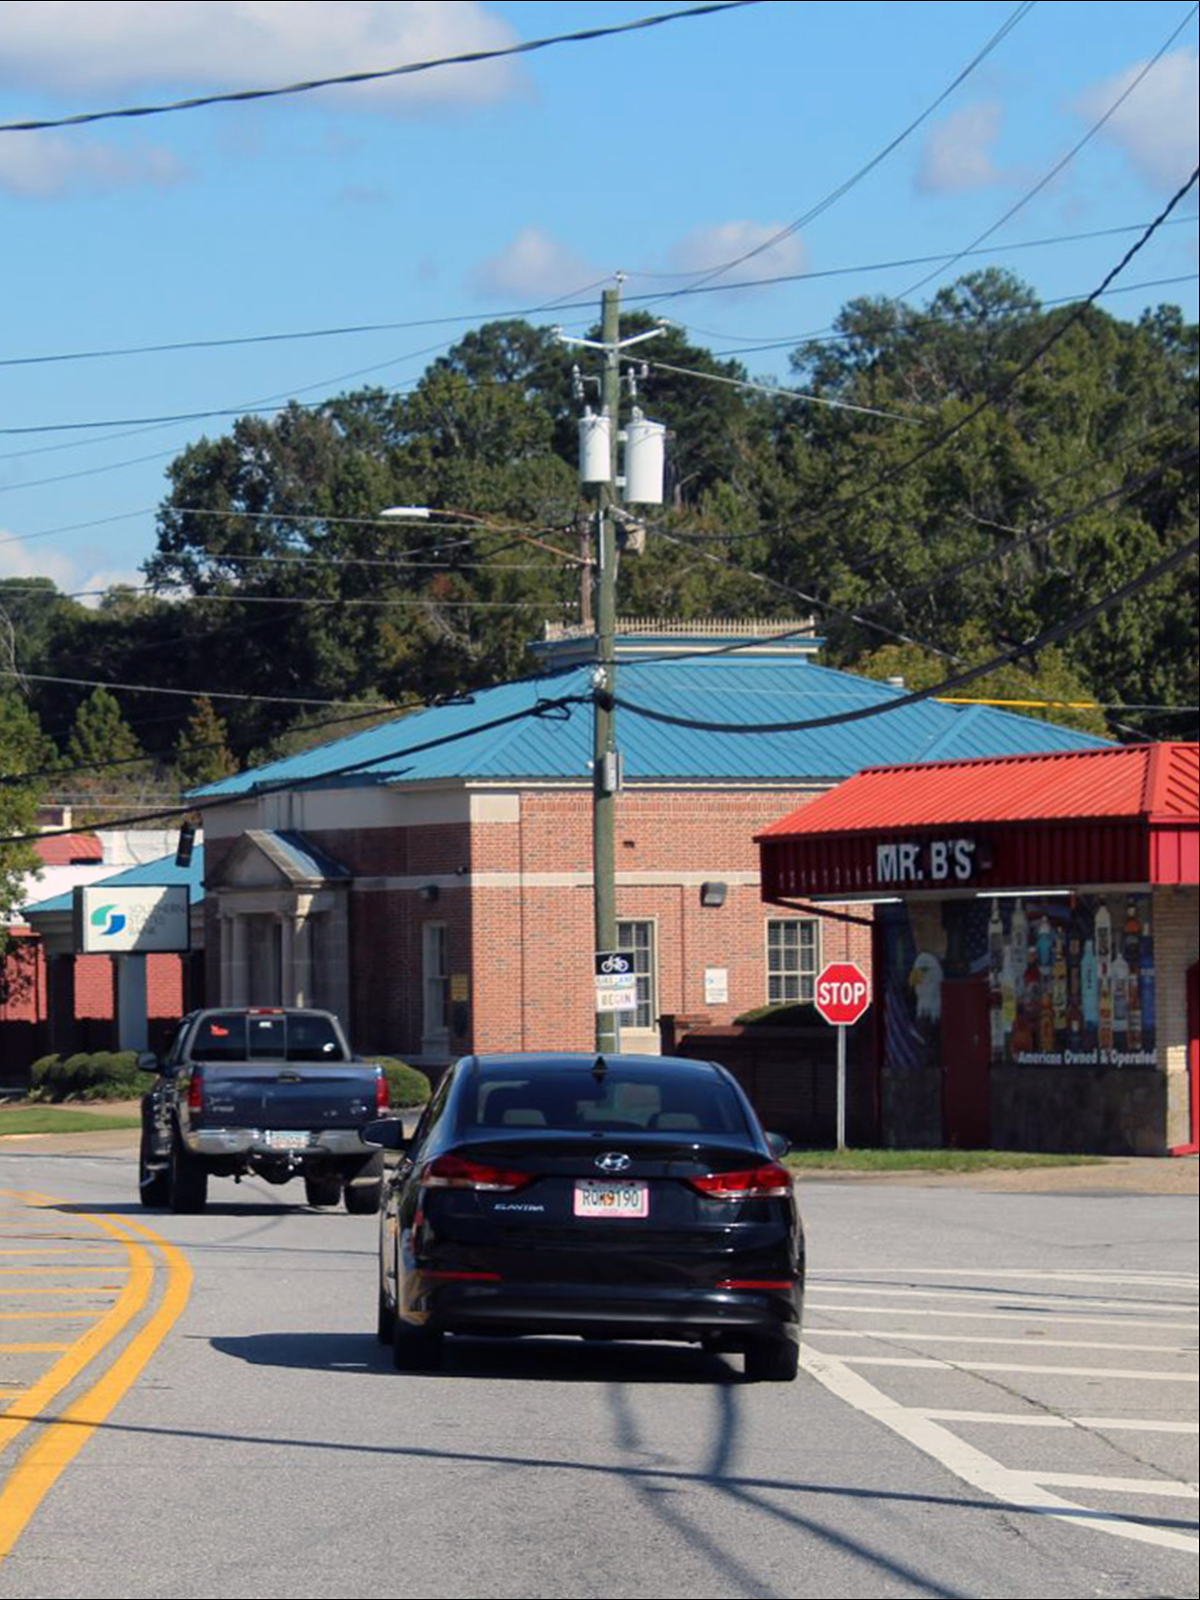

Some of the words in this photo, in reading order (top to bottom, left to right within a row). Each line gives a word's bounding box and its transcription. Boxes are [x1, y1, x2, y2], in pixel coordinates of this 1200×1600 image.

[877, 844, 923, 882] MR.
[930, 839, 972, 880] B'S
[819, 982, 865, 1006] STOP
[1018, 1051, 1062, 1064] American
[1064, 1049, 1097, 1065] Owned
[1110, 1049, 1158, 1068] Operated
